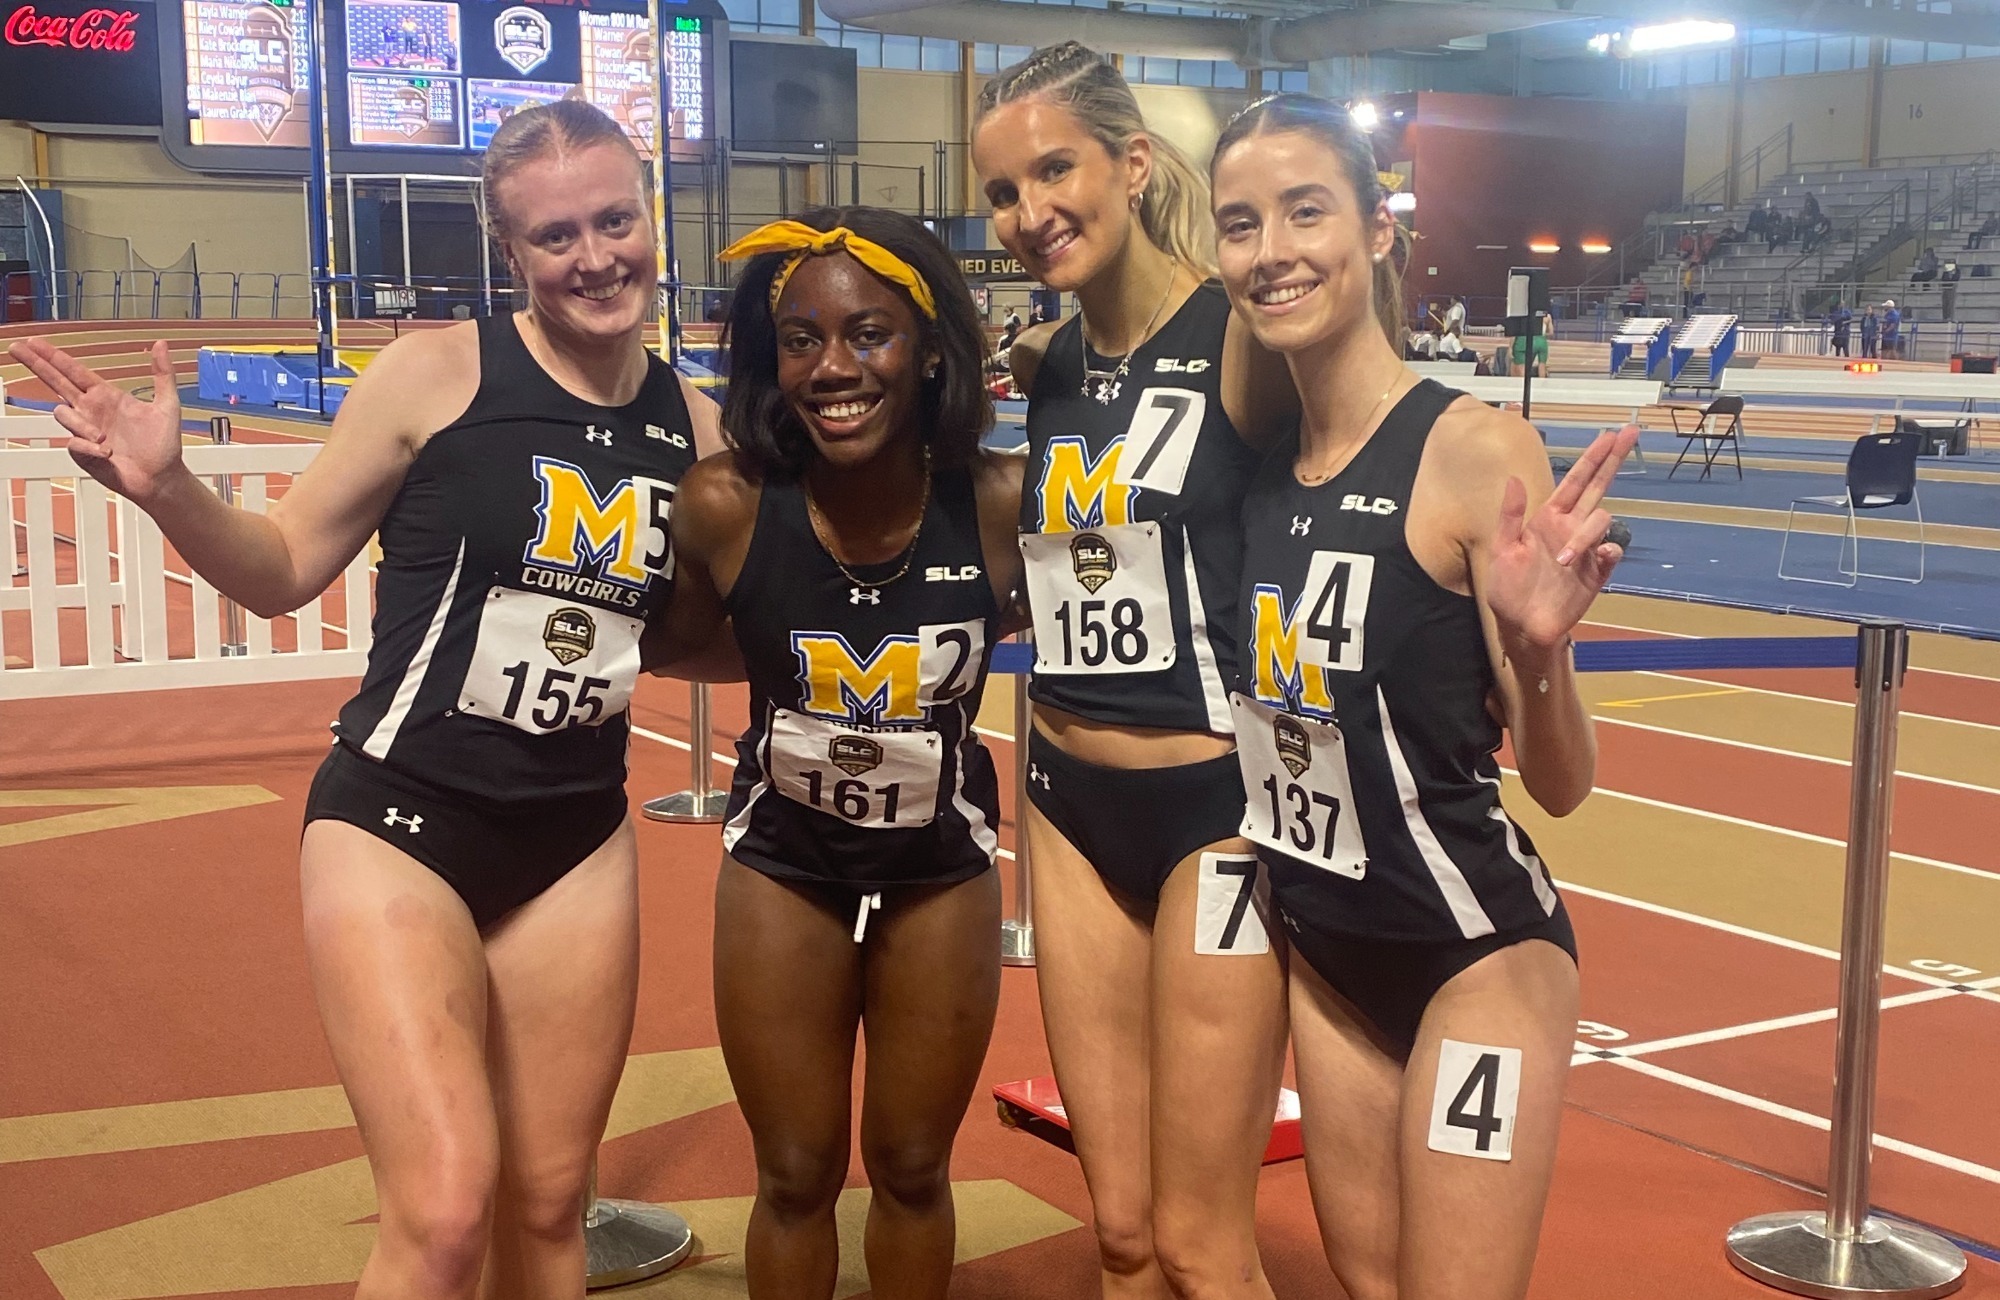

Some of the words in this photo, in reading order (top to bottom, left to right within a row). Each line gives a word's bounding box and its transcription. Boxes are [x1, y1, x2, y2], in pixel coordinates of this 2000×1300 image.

[5, 5, 139, 51] Coca-Cola
[579, 10, 610, 27] Women
[1909, 104, 1923, 119] 16
[1131, 395, 1192, 480] 7
[522, 455, 652, 592] M
[1035, 434, 1142, 534] M
[642, 484, 677, 573] 5
[521, 567, 641, 608] COWGIRLS
[1307, 561, 1352, 663] 4
[933, 628, 972, 701] 2
[1055, 598, 1149, 667] 158
[1248, 583, 1335, 719] M
[502, 660, 611, 729] 155
[790, 630, 932, 726] M
[799, 770, 901, 823] 161
[1263, 773, 1341, 860] 137
[1216, 860, 1258, 950] 7
[1910, 959, 1982, 977] 5
[1446, 1053, 1502, 1152] 4
